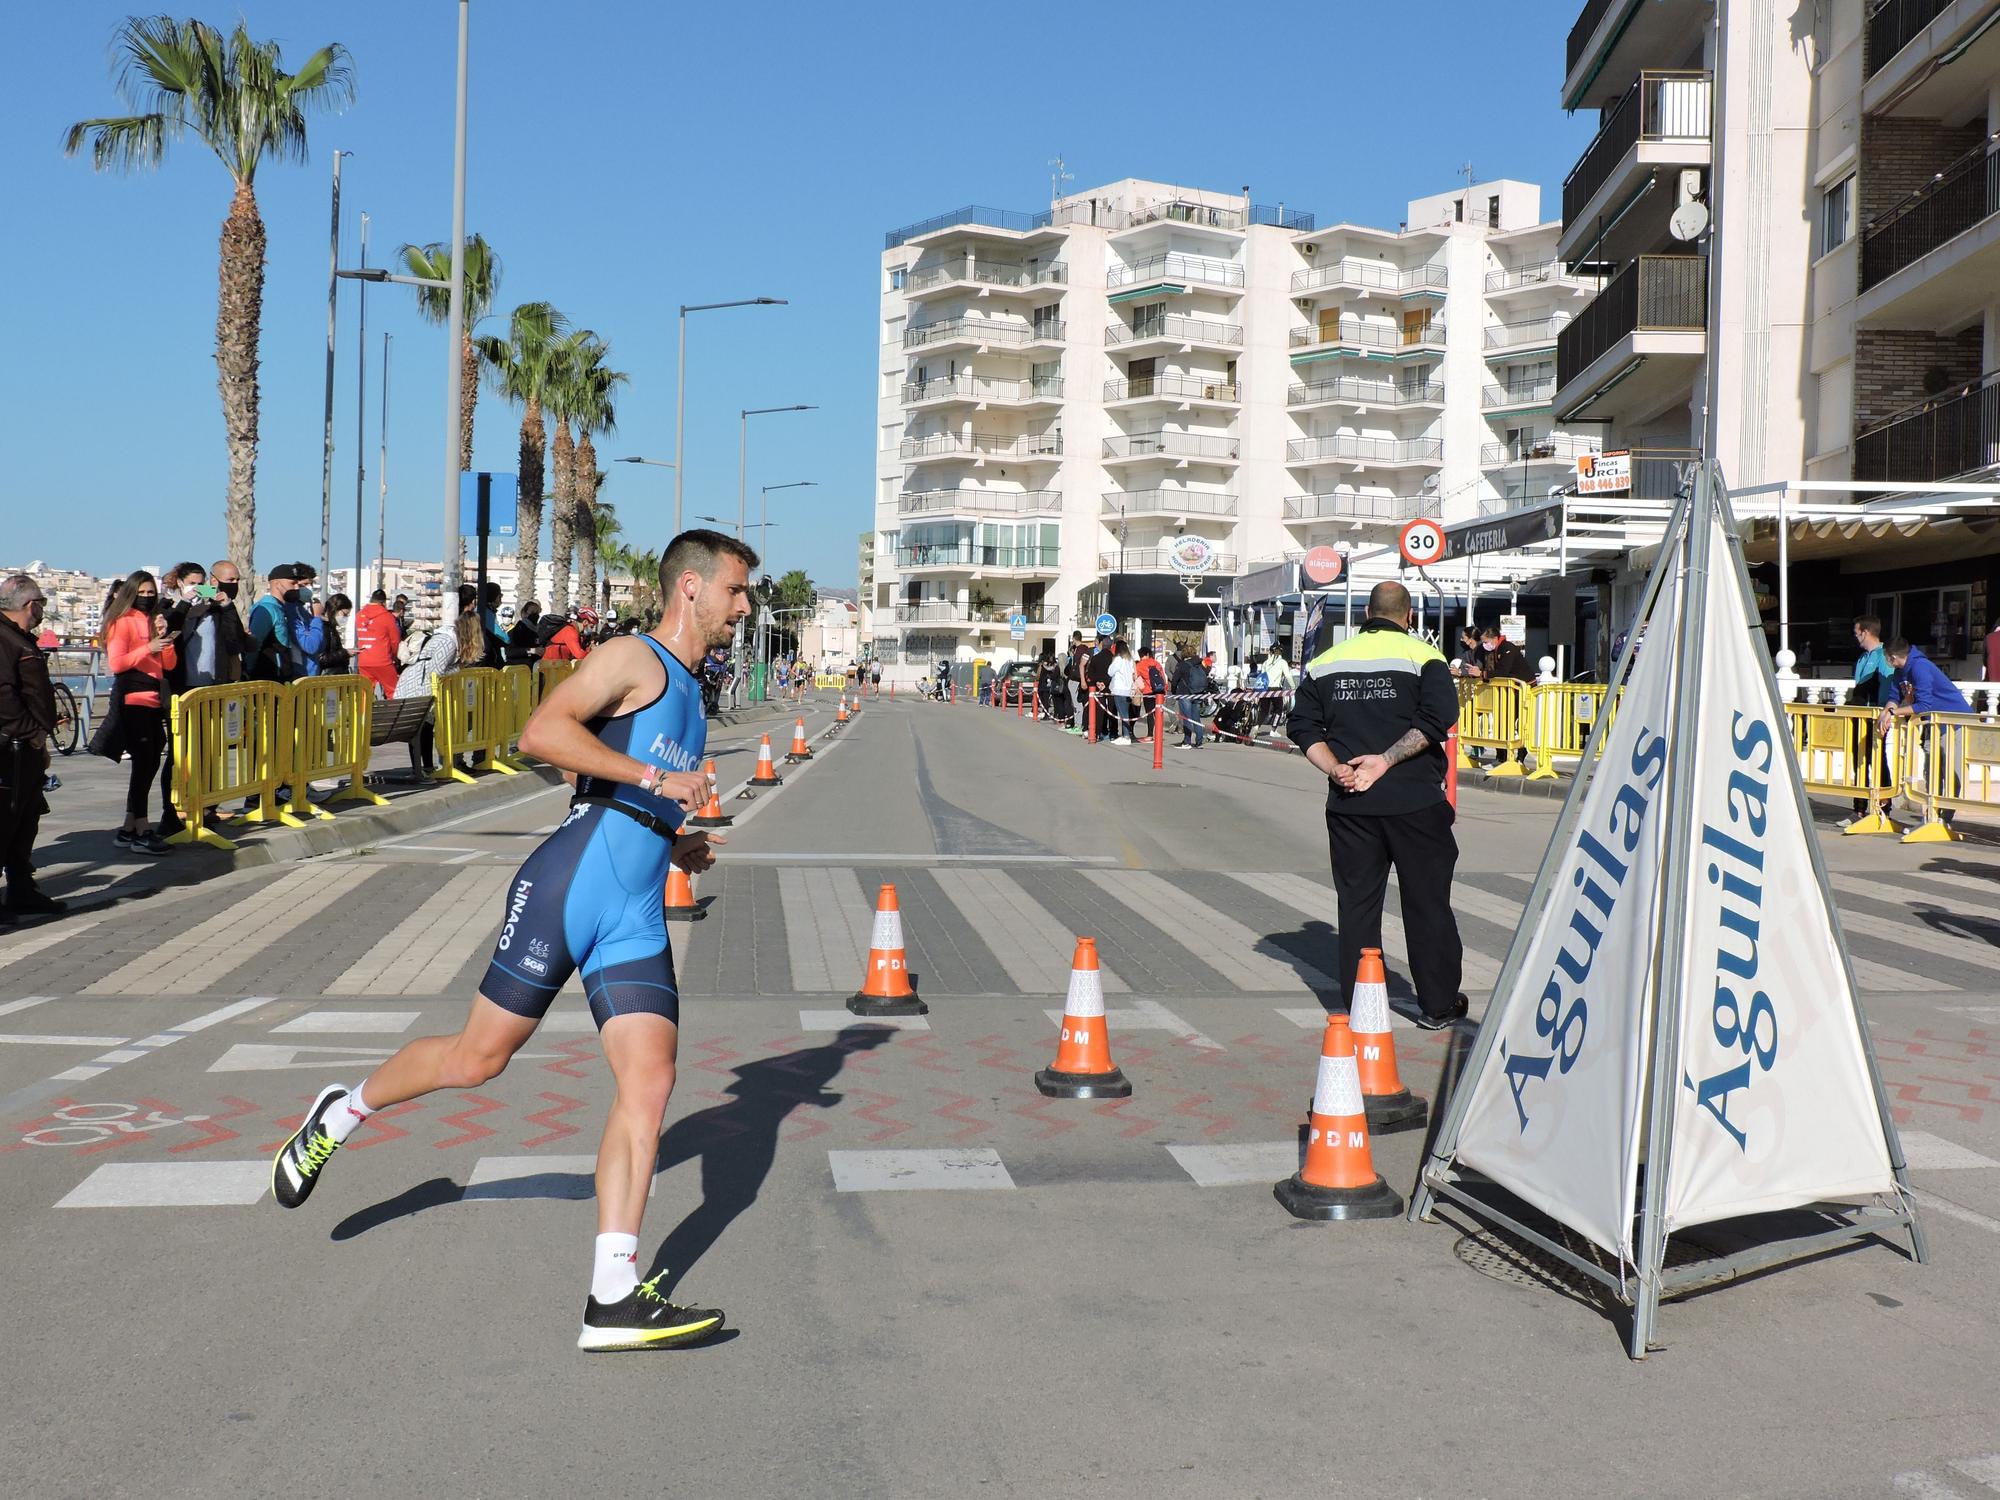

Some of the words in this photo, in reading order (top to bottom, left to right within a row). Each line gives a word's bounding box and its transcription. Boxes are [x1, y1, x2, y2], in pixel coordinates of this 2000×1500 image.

[1591, 457, 1618, 470] Fincas
[1579, 480, 1596, 492] 968
[1598, 478, 1613, 490] 446
[1615, 475, 1630, 489] 839
[1410, 535, 1435, 550] 30
[1464, 527, 1508, 553] CAFETERIA
[1334, 677, 1393, 690] SERVICIOS
[1332, 688, 1398, 701] AUXILIARES
[1500, 726, 1666, 1136] Águilas
[1684, 709, 1777, 1155] Águilas
[523, 957, 545, 973] SGR
